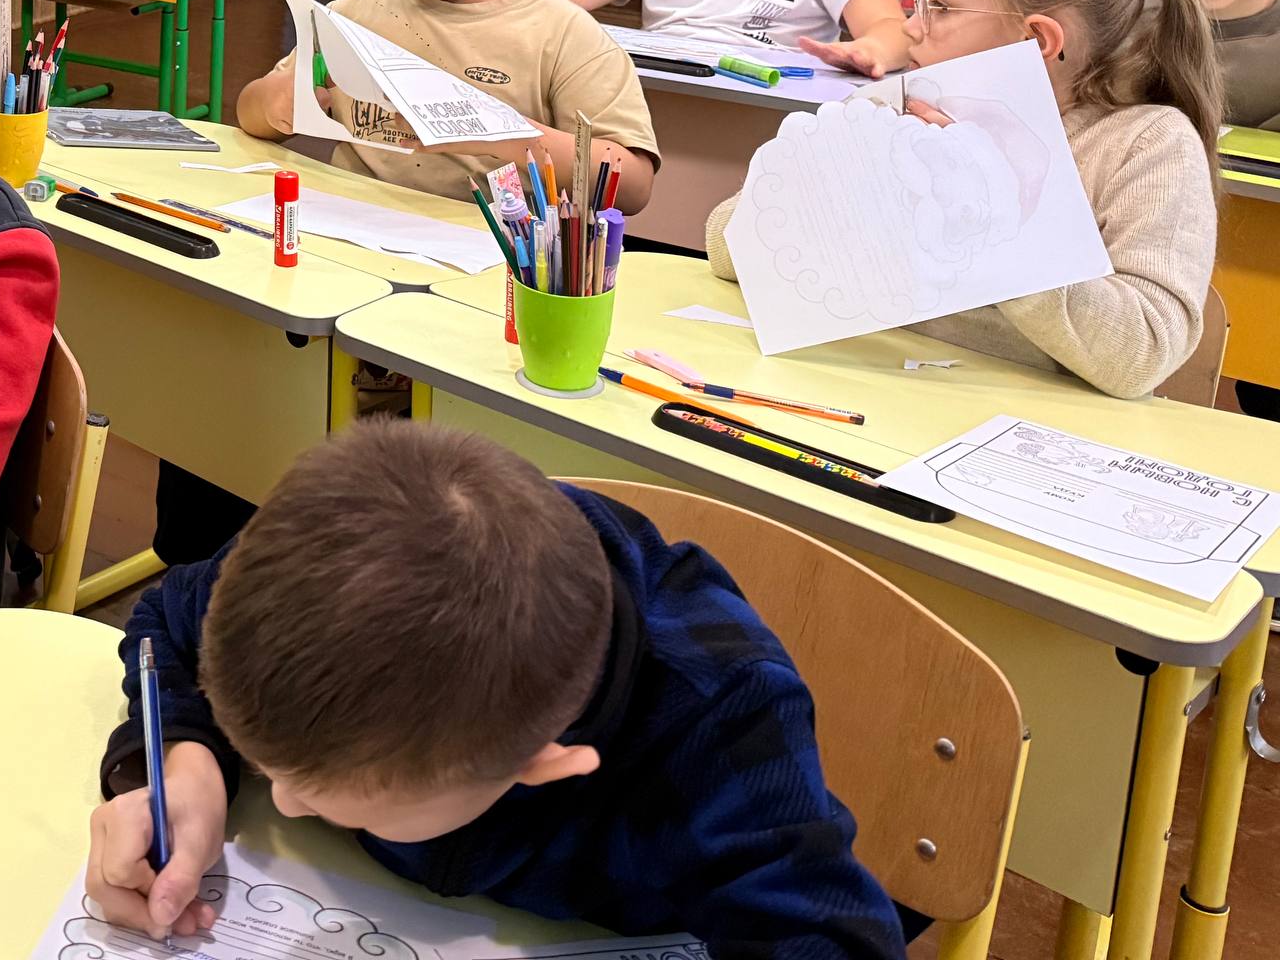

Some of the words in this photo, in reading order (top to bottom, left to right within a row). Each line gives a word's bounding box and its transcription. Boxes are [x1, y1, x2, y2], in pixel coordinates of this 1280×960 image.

[424, 99, 478, 119] НОВЫМ
[428, 117, 488, 136] ГОДОМ!
[506, 281, 514, 321] BRAUBERG
[1108, 460, 1221, 499] НОВЫМ
[1125, 456, 1253, 499] ГОДОМ!
[1042, 490, 1076, 503] КОМУ
[1051, 485, 1085, 498] КУДА
[1232, 497, 1253, 508] С
[293, 939, 305, 947] ты
[306, 942, 321, 950] что
